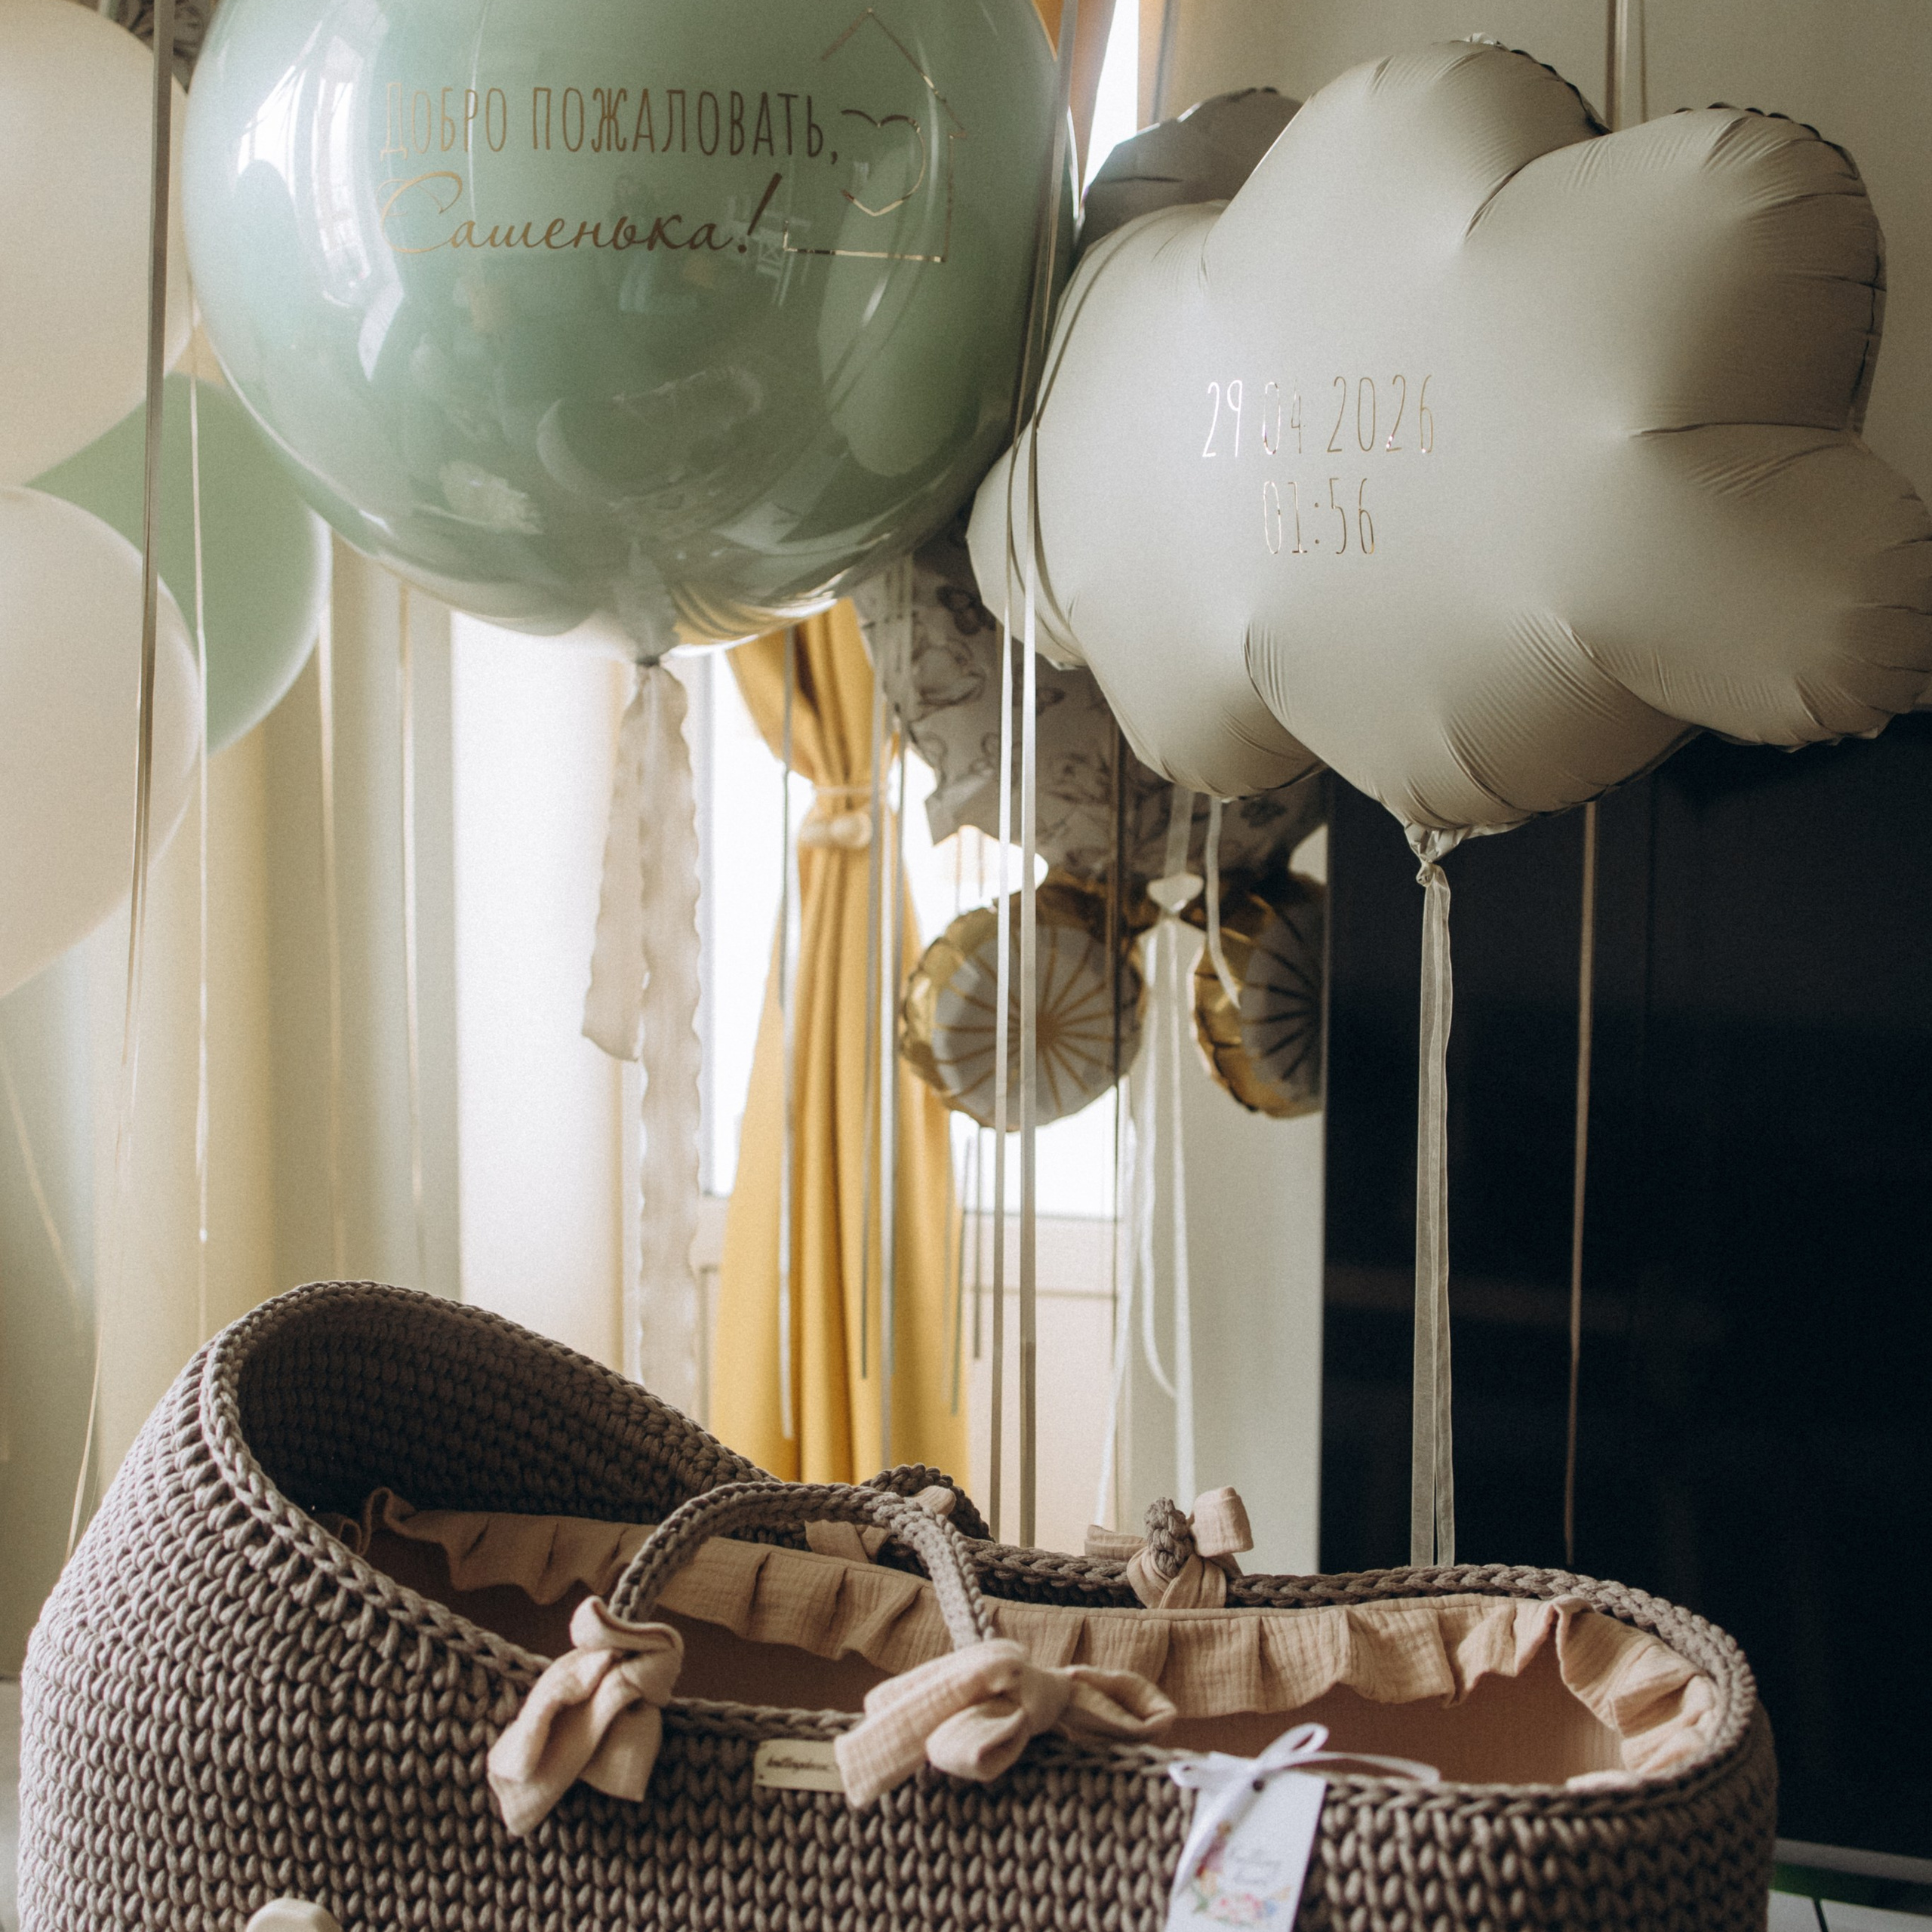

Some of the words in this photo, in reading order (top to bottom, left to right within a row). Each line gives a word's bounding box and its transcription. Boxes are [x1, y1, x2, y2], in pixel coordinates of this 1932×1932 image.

[380, 82, 507, 162] ДОБРО
[531, 87, 840, 165] ПОЖАЛОВАТЬ,
[375, 171, 783, 254] Сашенька!
[1202, 380, 1243, 457] 29
[1326, 374, 1434, 454] 2026
[1263, 478, 1375, 554] 01:56
